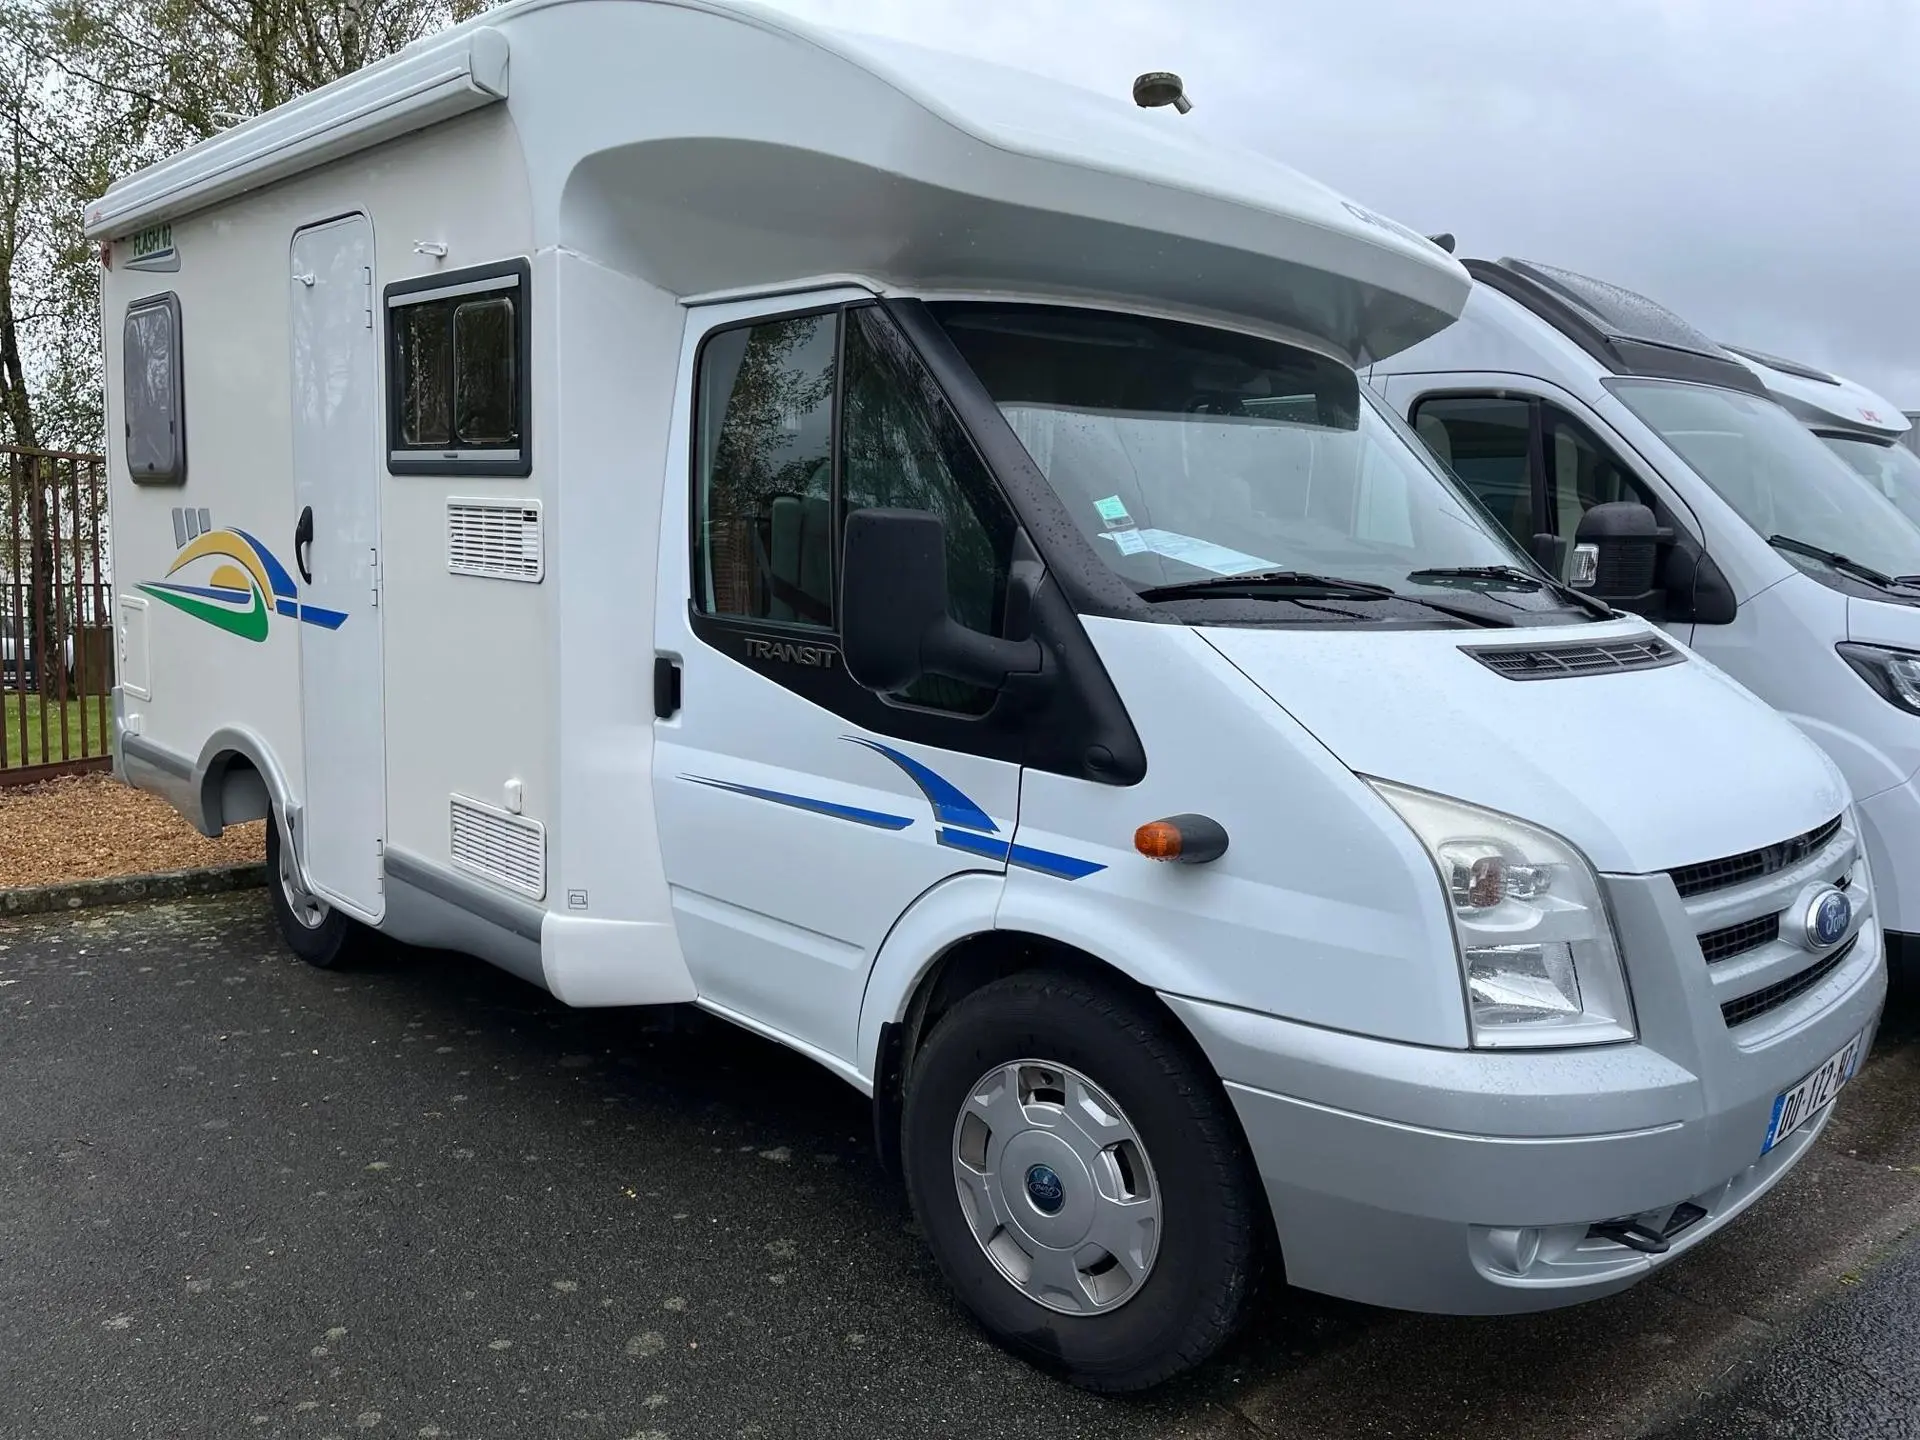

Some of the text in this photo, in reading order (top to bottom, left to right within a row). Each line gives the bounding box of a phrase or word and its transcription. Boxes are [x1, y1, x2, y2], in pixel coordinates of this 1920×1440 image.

[133, 226, 160, 257] FLASH
[744, 638, 837, 668] TRANSIT
[1826, 903, 1847, 936] Ford
